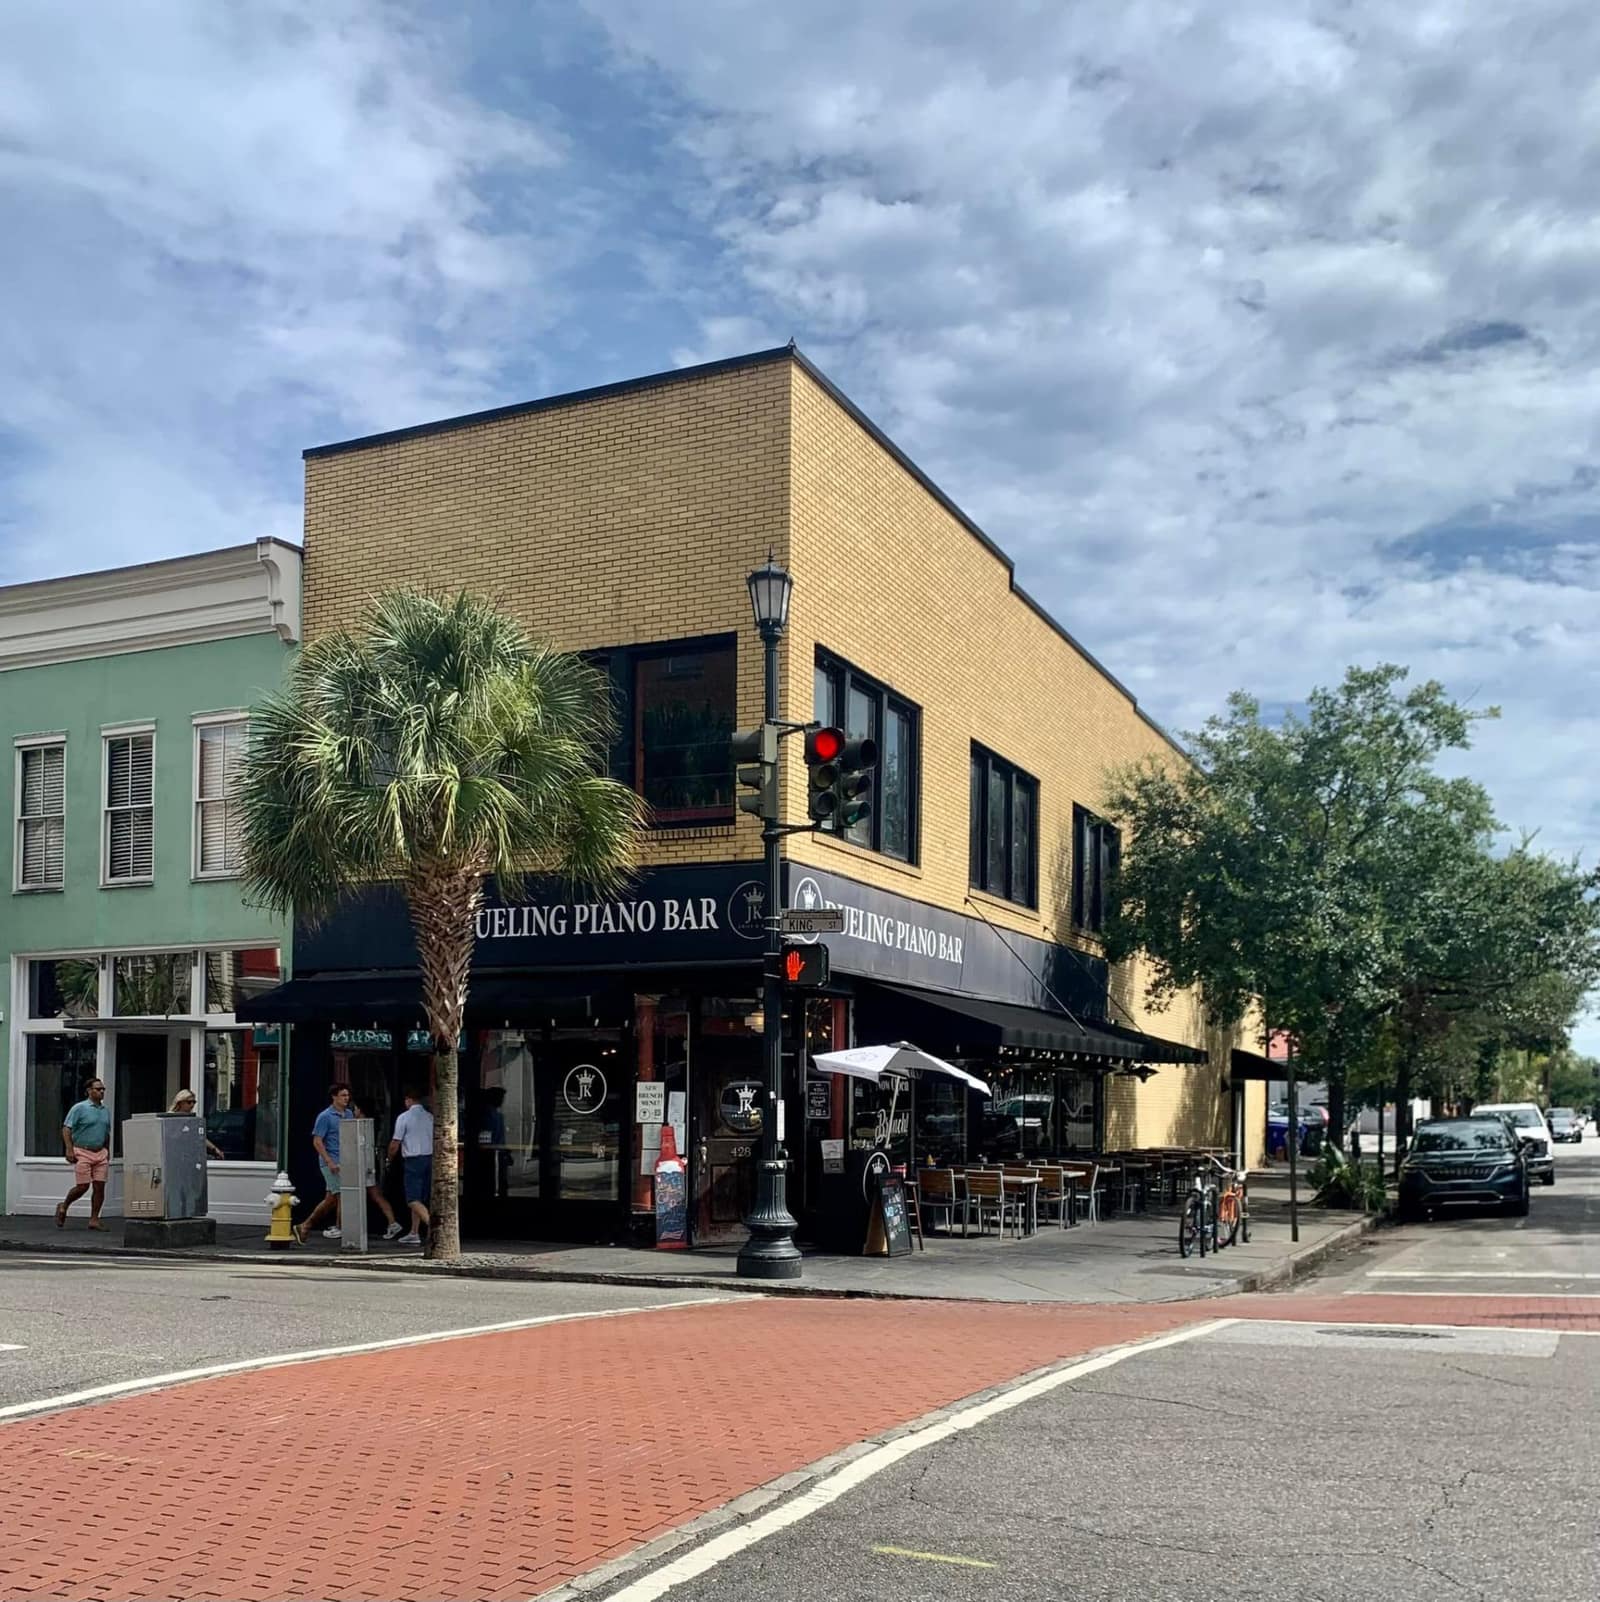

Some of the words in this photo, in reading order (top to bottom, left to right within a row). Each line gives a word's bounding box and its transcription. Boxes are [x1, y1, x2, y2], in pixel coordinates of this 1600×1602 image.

[474, 903, 568, 938] UELING
[574, 900, 656, 934] PIANO
[663, 898, 719, 931] BAR
[789, 919, 813, 931] KING
[828, 921, 836, 930] ST
[896, 921, 935, 958] PIANO
[938, 934, 963, 964] BAR
[578, 1085, 592, 1100] JK
[737, 1099, 753, 1114] JK
[730, 1146, 752, 1158] 428
